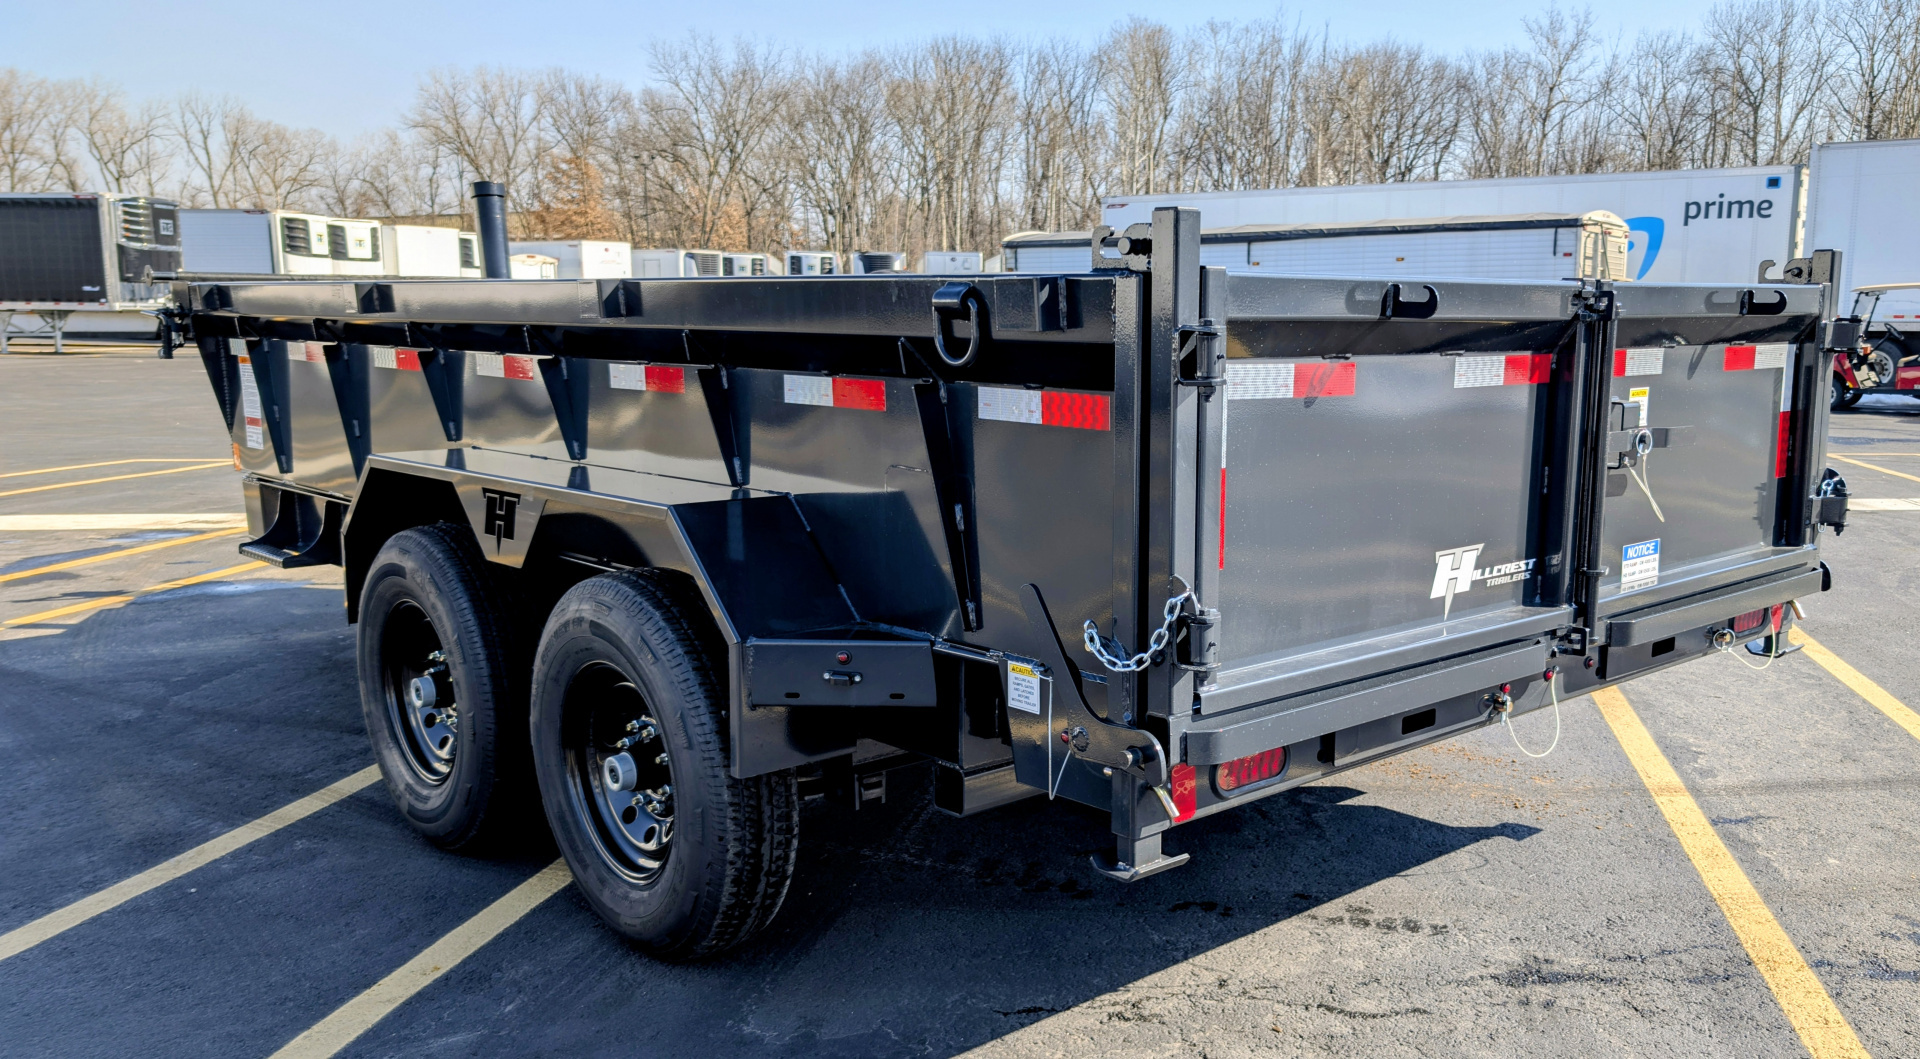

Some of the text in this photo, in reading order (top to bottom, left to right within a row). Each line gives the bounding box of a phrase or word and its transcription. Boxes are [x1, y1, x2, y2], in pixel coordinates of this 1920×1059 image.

[1683, 193, 1773, 226] prime
[1627, 542, 1656, 559] NOTICE
[1430, 543, 1536, 619] HILLCREST
[1486, 571, 1532, 588] TRAILERS
